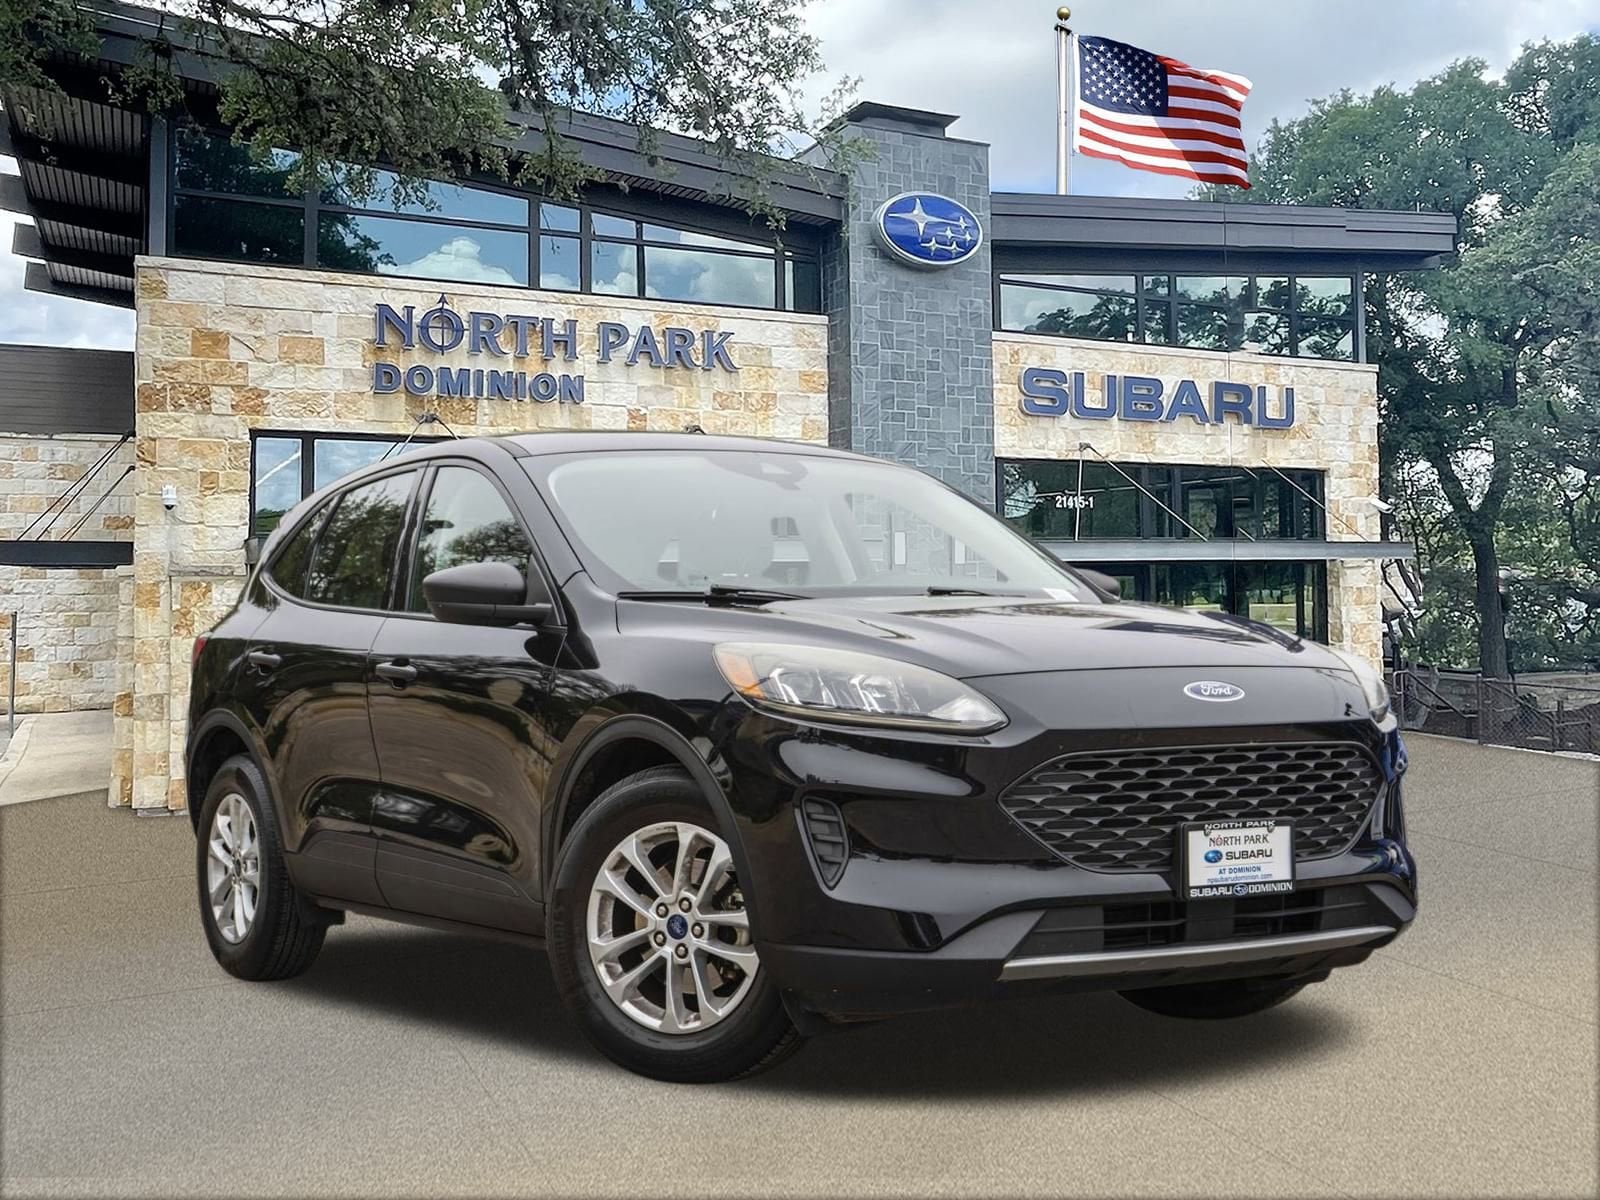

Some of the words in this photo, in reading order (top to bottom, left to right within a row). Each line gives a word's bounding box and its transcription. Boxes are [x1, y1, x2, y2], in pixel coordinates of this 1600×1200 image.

[374, 298, 579, 361] NORTH
[597, 321, 741, 373] PARK
[373, 362, 585, 404] DOMINION
[1019, 367, 1295, 430] SUBARU
[1055, 495, 1094, 509] 21415-1
[1200, 683, 1233, 696] Ford
[1205, 822, 1242, 830] NORTH
[1209, 834, 1241, 847] NORTH
[1244, 834, 1269, 844] PARK
[1225, 849, 1272, 860] SUBARU
[1190, 886, 1233, 897] SUBARU
[1249, 882, 1292, 893] DOMINION
